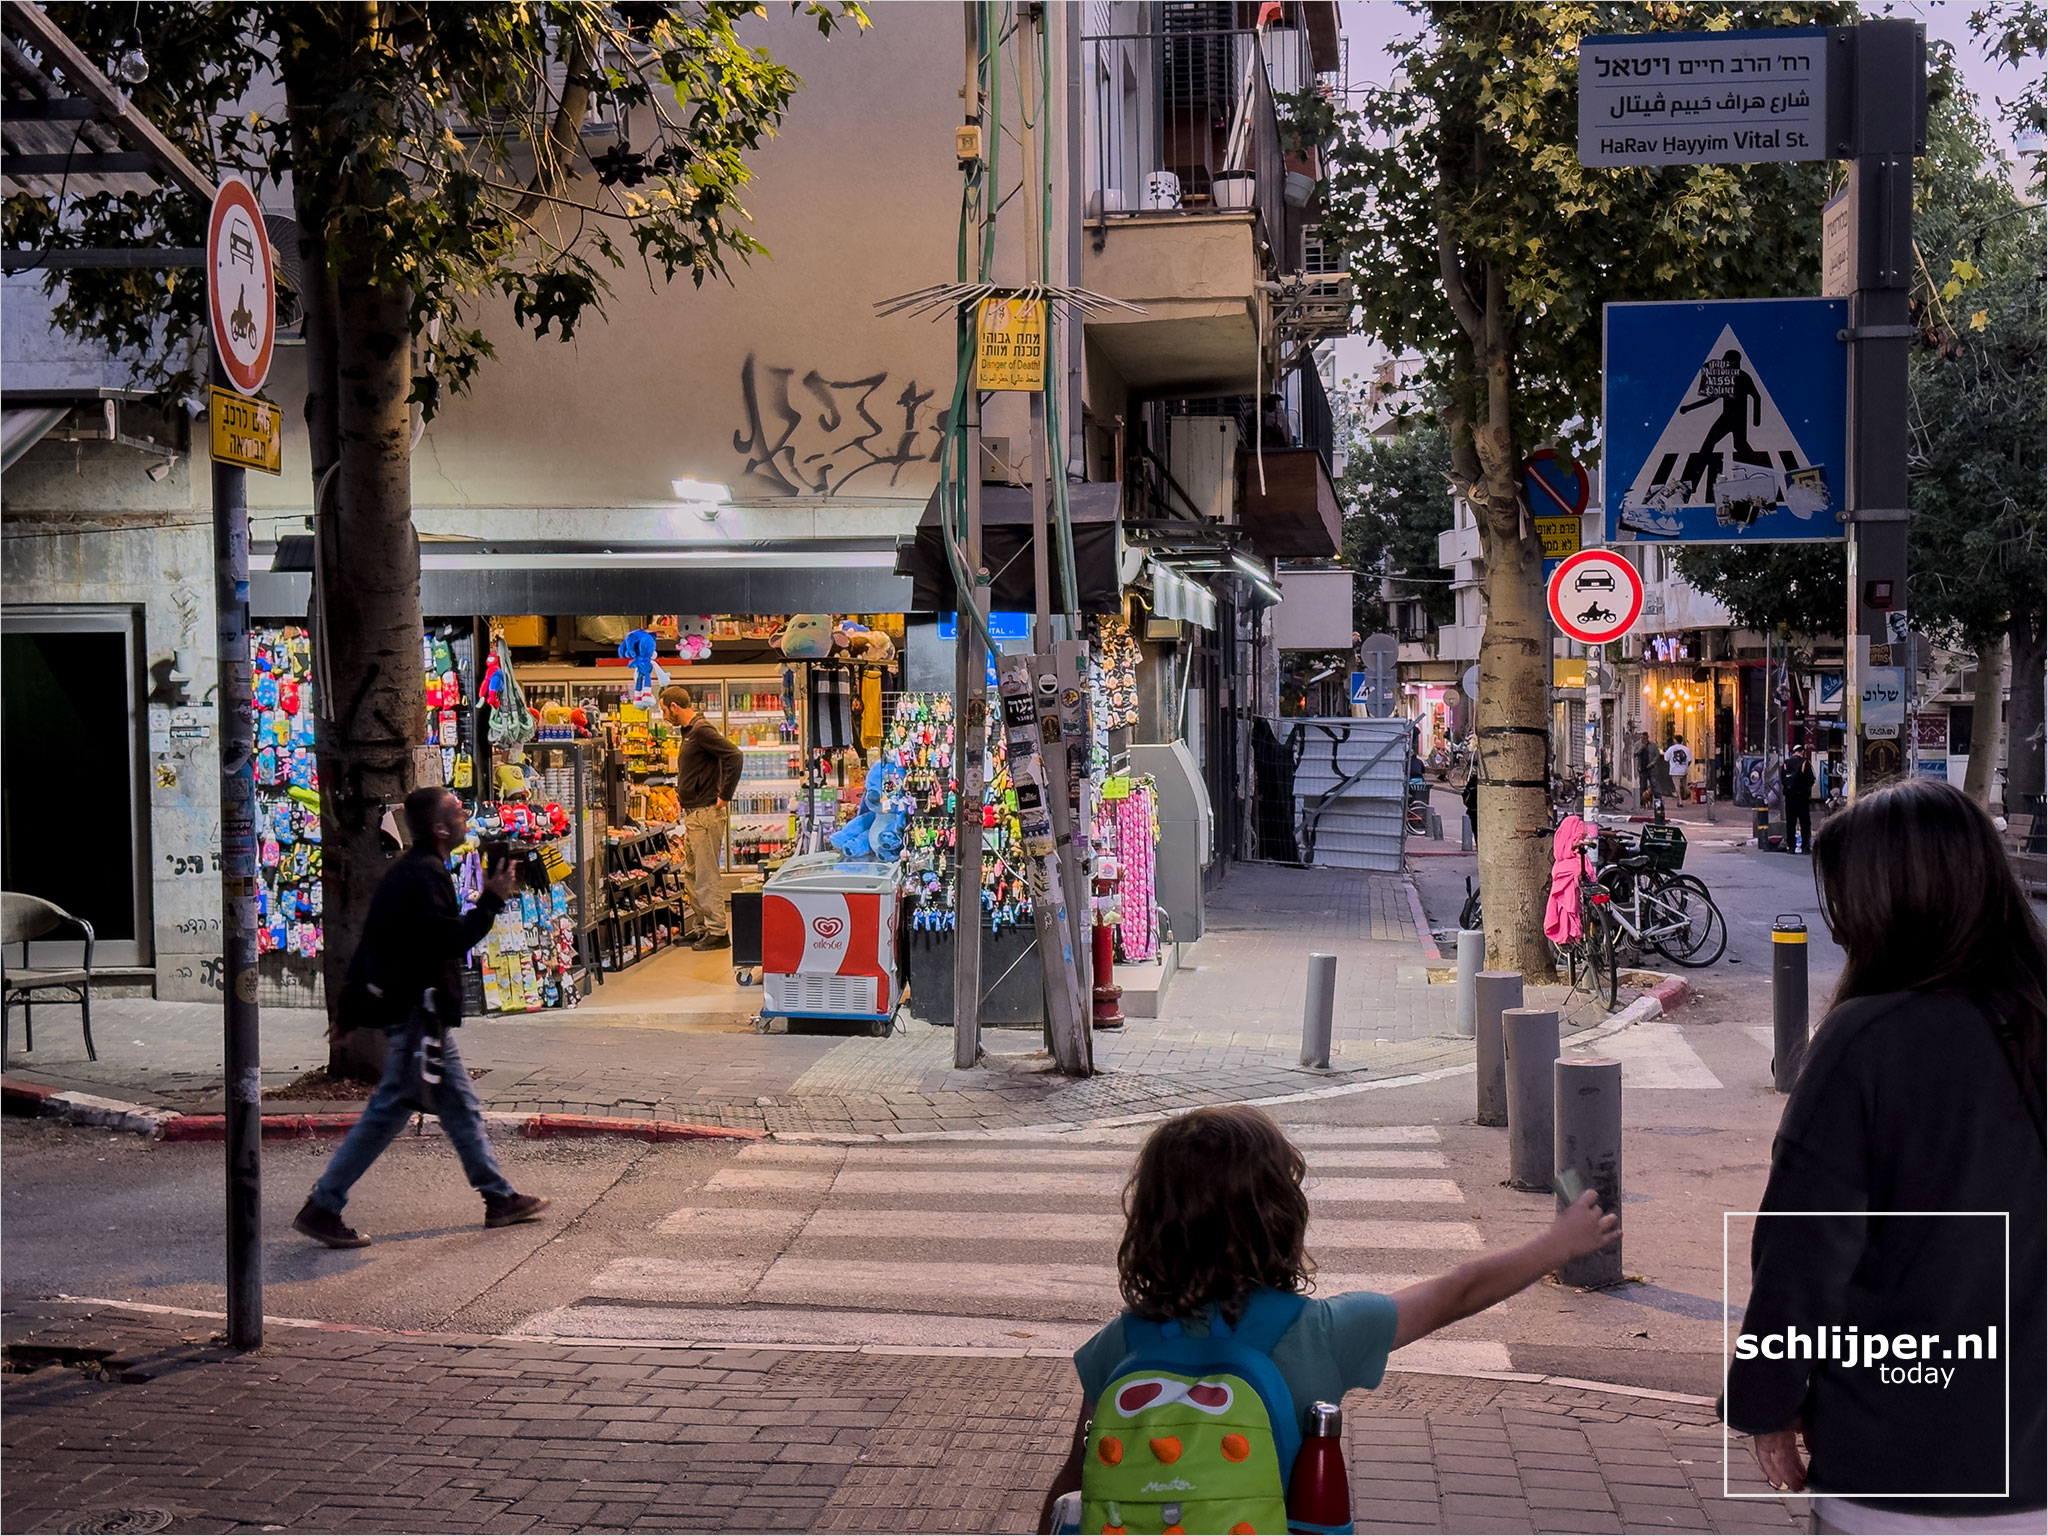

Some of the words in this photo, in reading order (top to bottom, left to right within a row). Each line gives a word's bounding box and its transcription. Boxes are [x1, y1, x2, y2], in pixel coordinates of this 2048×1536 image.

[1594, 56, 1670, 78] ויטאל
[1679, 59, 1724, 75] חיים
[1731, 57, 1771, 73] הרב
[1769, 90, 1810, 113] شارع
[1601, 138, 1657, 154] HaRav
[1733, 129, 1780, 149] Vital
[1786, 132, 1809, 147] St.
[982, 332, 1011, 344] גבוה!
[1017, 333, 1040, 344] מתח
[981, 345, 1008, 356] מוות!
[1013, 345, 1040, 357] סכנת
[981, 359, 1007, 371] Danger
[1008, 360, 1017, 370] of
[223, 404, 247, 429] לרכב
[1862, 683, 1899, 701] שלום
